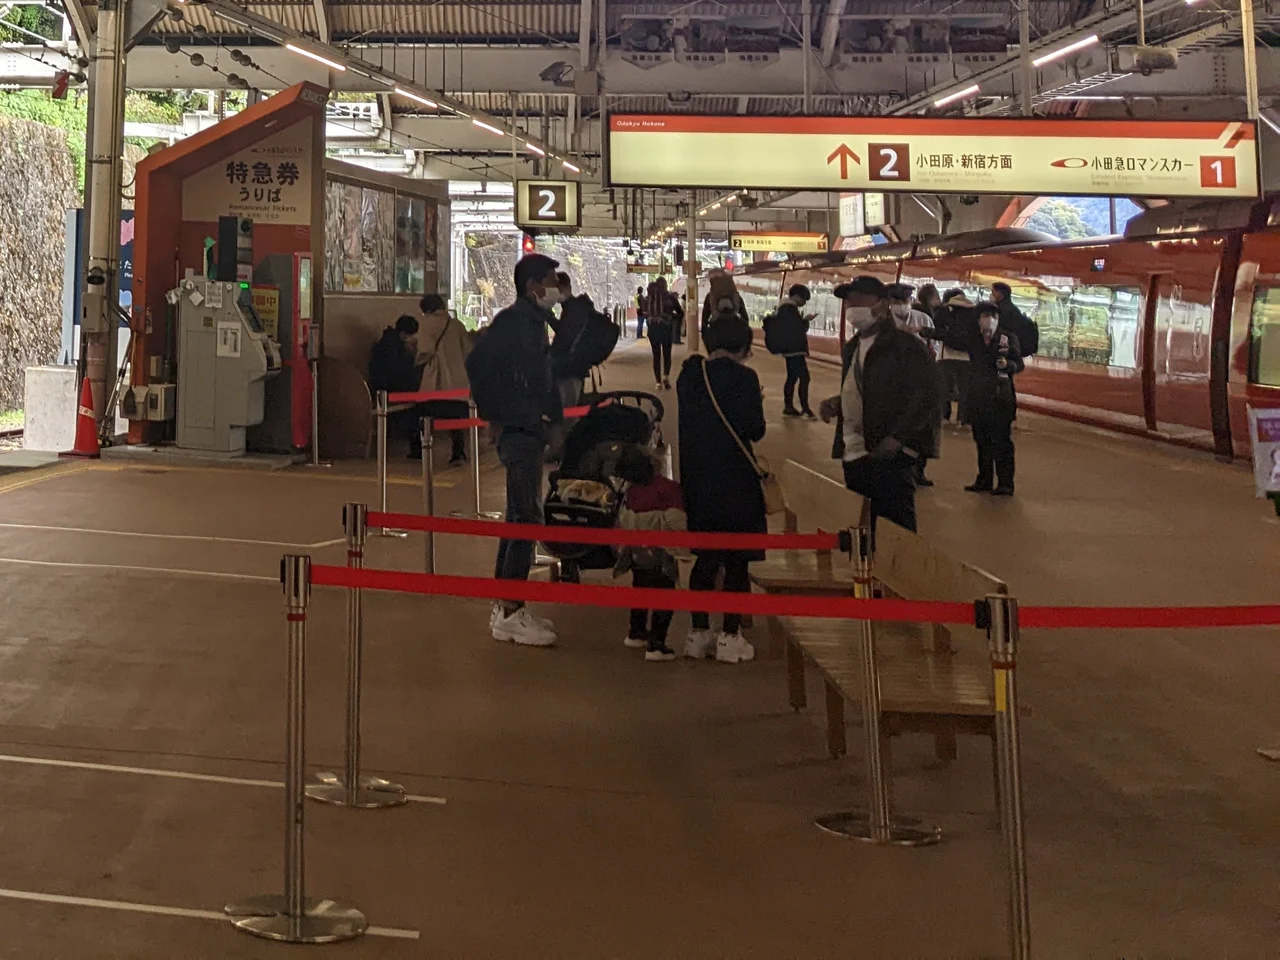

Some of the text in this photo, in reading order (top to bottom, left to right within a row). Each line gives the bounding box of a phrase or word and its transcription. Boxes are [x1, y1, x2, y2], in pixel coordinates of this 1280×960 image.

[225, 161, 300, 186] 特急券
[879, 148, 899, 176] 2
[916, 153, 1012, 170] 小田原・新宿方面
[1091, 156, 1194, 172] 小田急ロマンスカー
[1210, 160, 1223, 184] 1
[239, 187, 282, 203] うりば
[537, 189, 557, 217] 2
